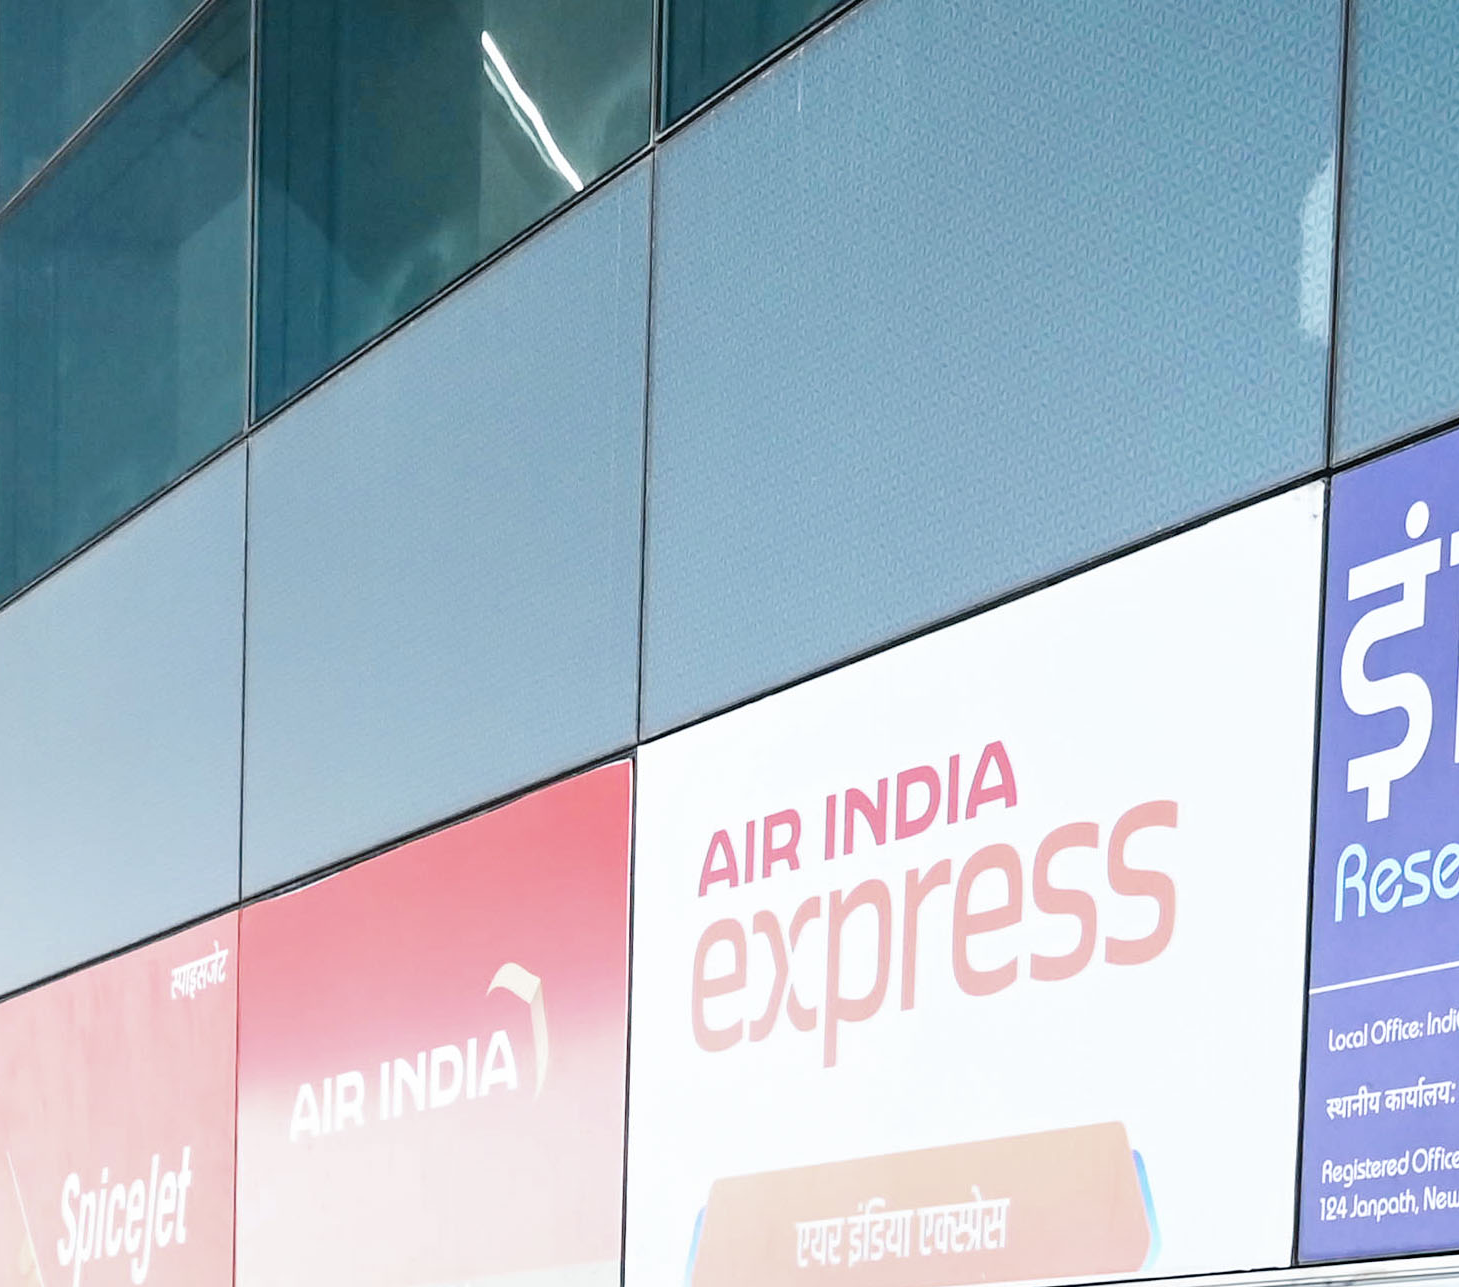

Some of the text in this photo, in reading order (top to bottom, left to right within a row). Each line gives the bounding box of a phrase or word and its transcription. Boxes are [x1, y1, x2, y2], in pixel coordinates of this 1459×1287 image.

[698, 740, 1018, 898] AIR INDIA
[690, 799, 1178, 1068] express
[1328, 1024, 1368, 1052] Local
[1370, 1018, 1424, 1045] Office:
[289, 1030, 519, 1141] AIR INDIA
[1326, 1081, 1381, 1120] स्थानीय
[1384, 1076, 1456, 1113] कार्यालय:
[1321, 1151, 1409, 1189] Registered
[795, 1217, 845, 1268] एयर
[846, 1197, 916, 1268] इंडिया
[1319, 1196, 1348, 1221] 124
[1349, 1189, 1420, 1223] Janpath,
